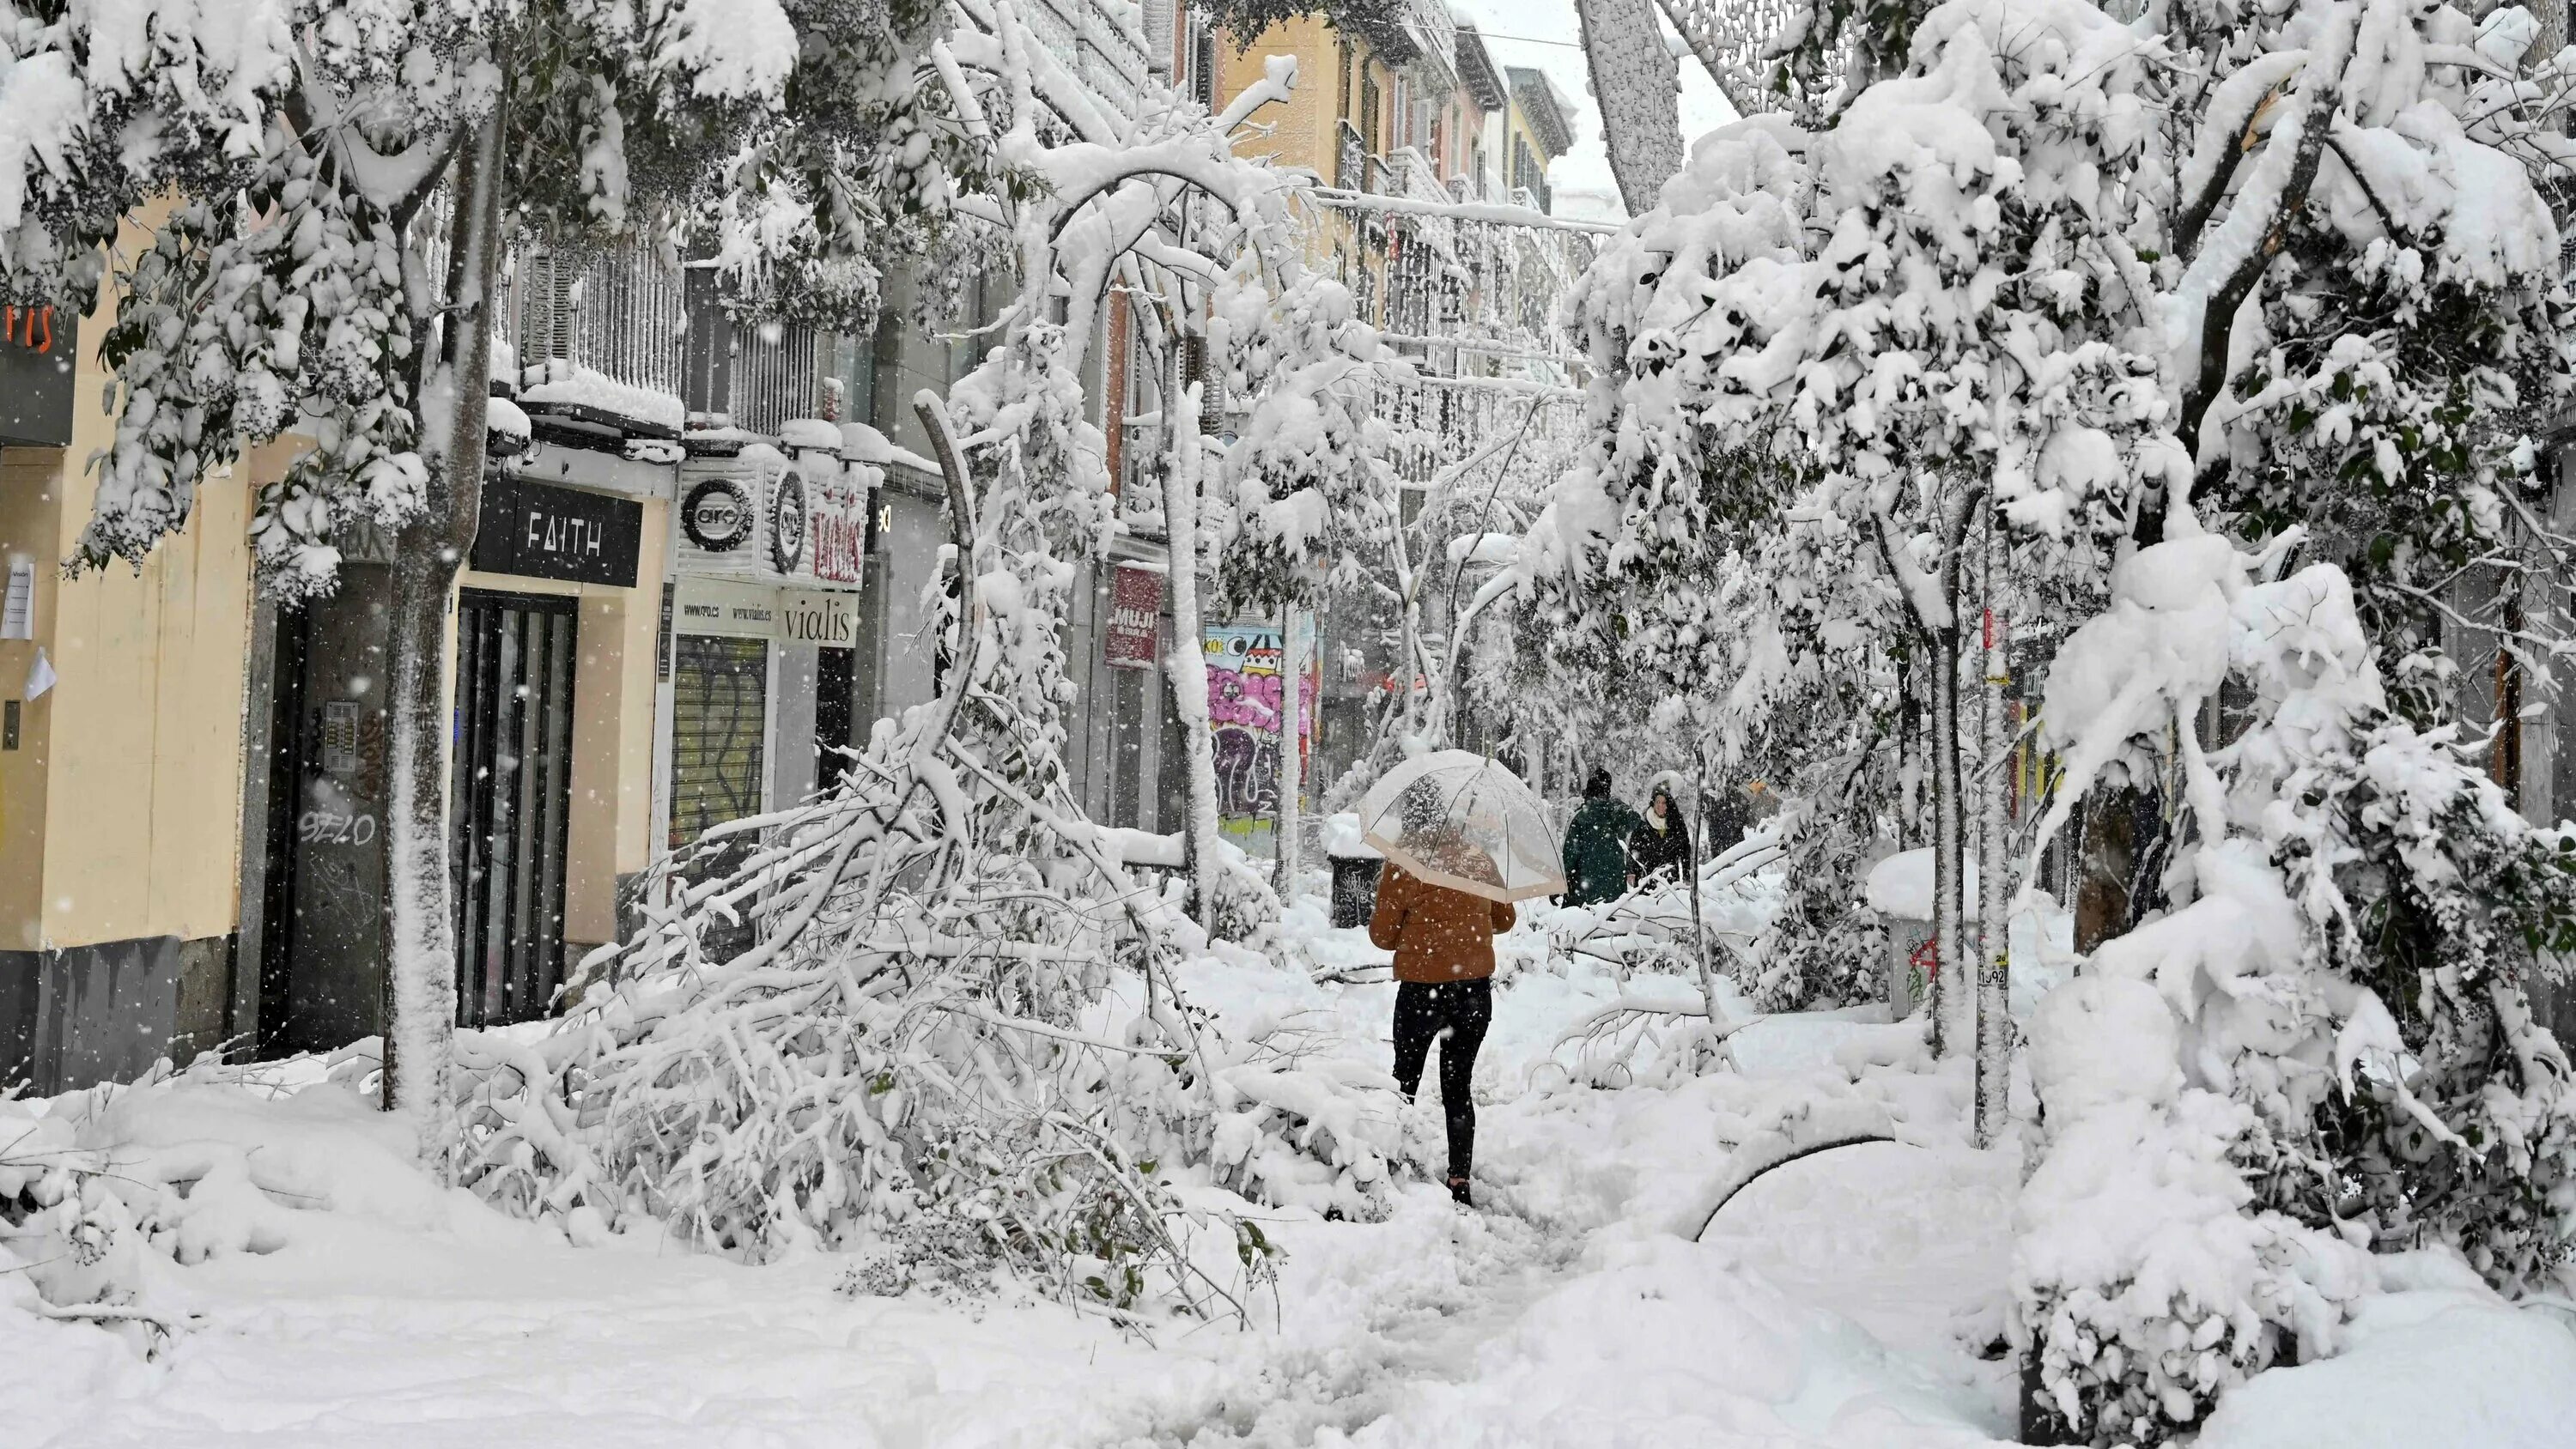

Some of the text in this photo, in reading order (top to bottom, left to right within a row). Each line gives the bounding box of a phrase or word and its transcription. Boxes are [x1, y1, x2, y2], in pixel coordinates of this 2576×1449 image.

[528, 512, 602, 557] FAITH
[785, 598, 850, 642] vialis
[1115, 607, 1154, 628] MUJI
